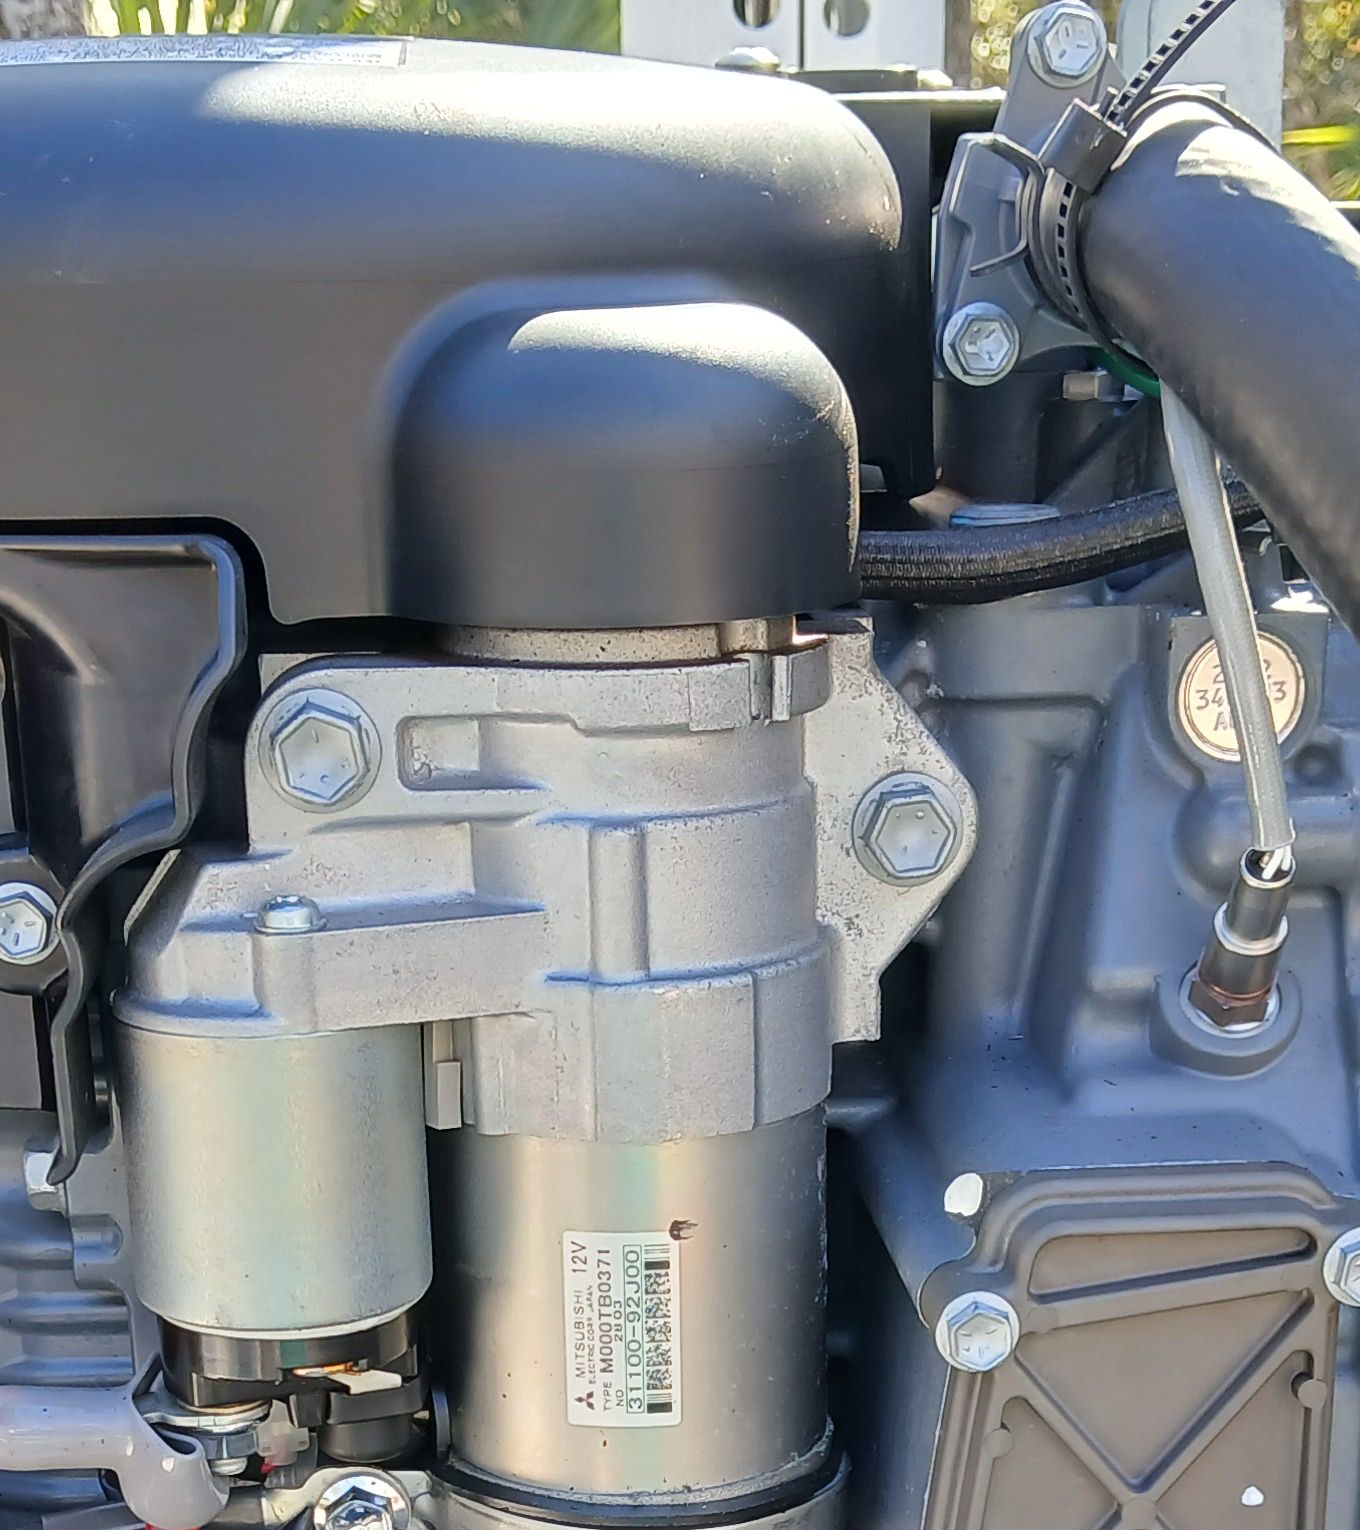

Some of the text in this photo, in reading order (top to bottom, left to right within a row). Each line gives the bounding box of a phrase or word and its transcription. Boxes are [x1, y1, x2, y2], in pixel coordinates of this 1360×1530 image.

[571, 1241, 587, 1274] 12V
[574, 1290, 585, 1379] MITSUBISHI
[597, 1249, 614, 1412] TYPE M000TB0371
[625, 1250, 643, 1410] 31100-92J00
[615, 1390, 624, 1407] NO
